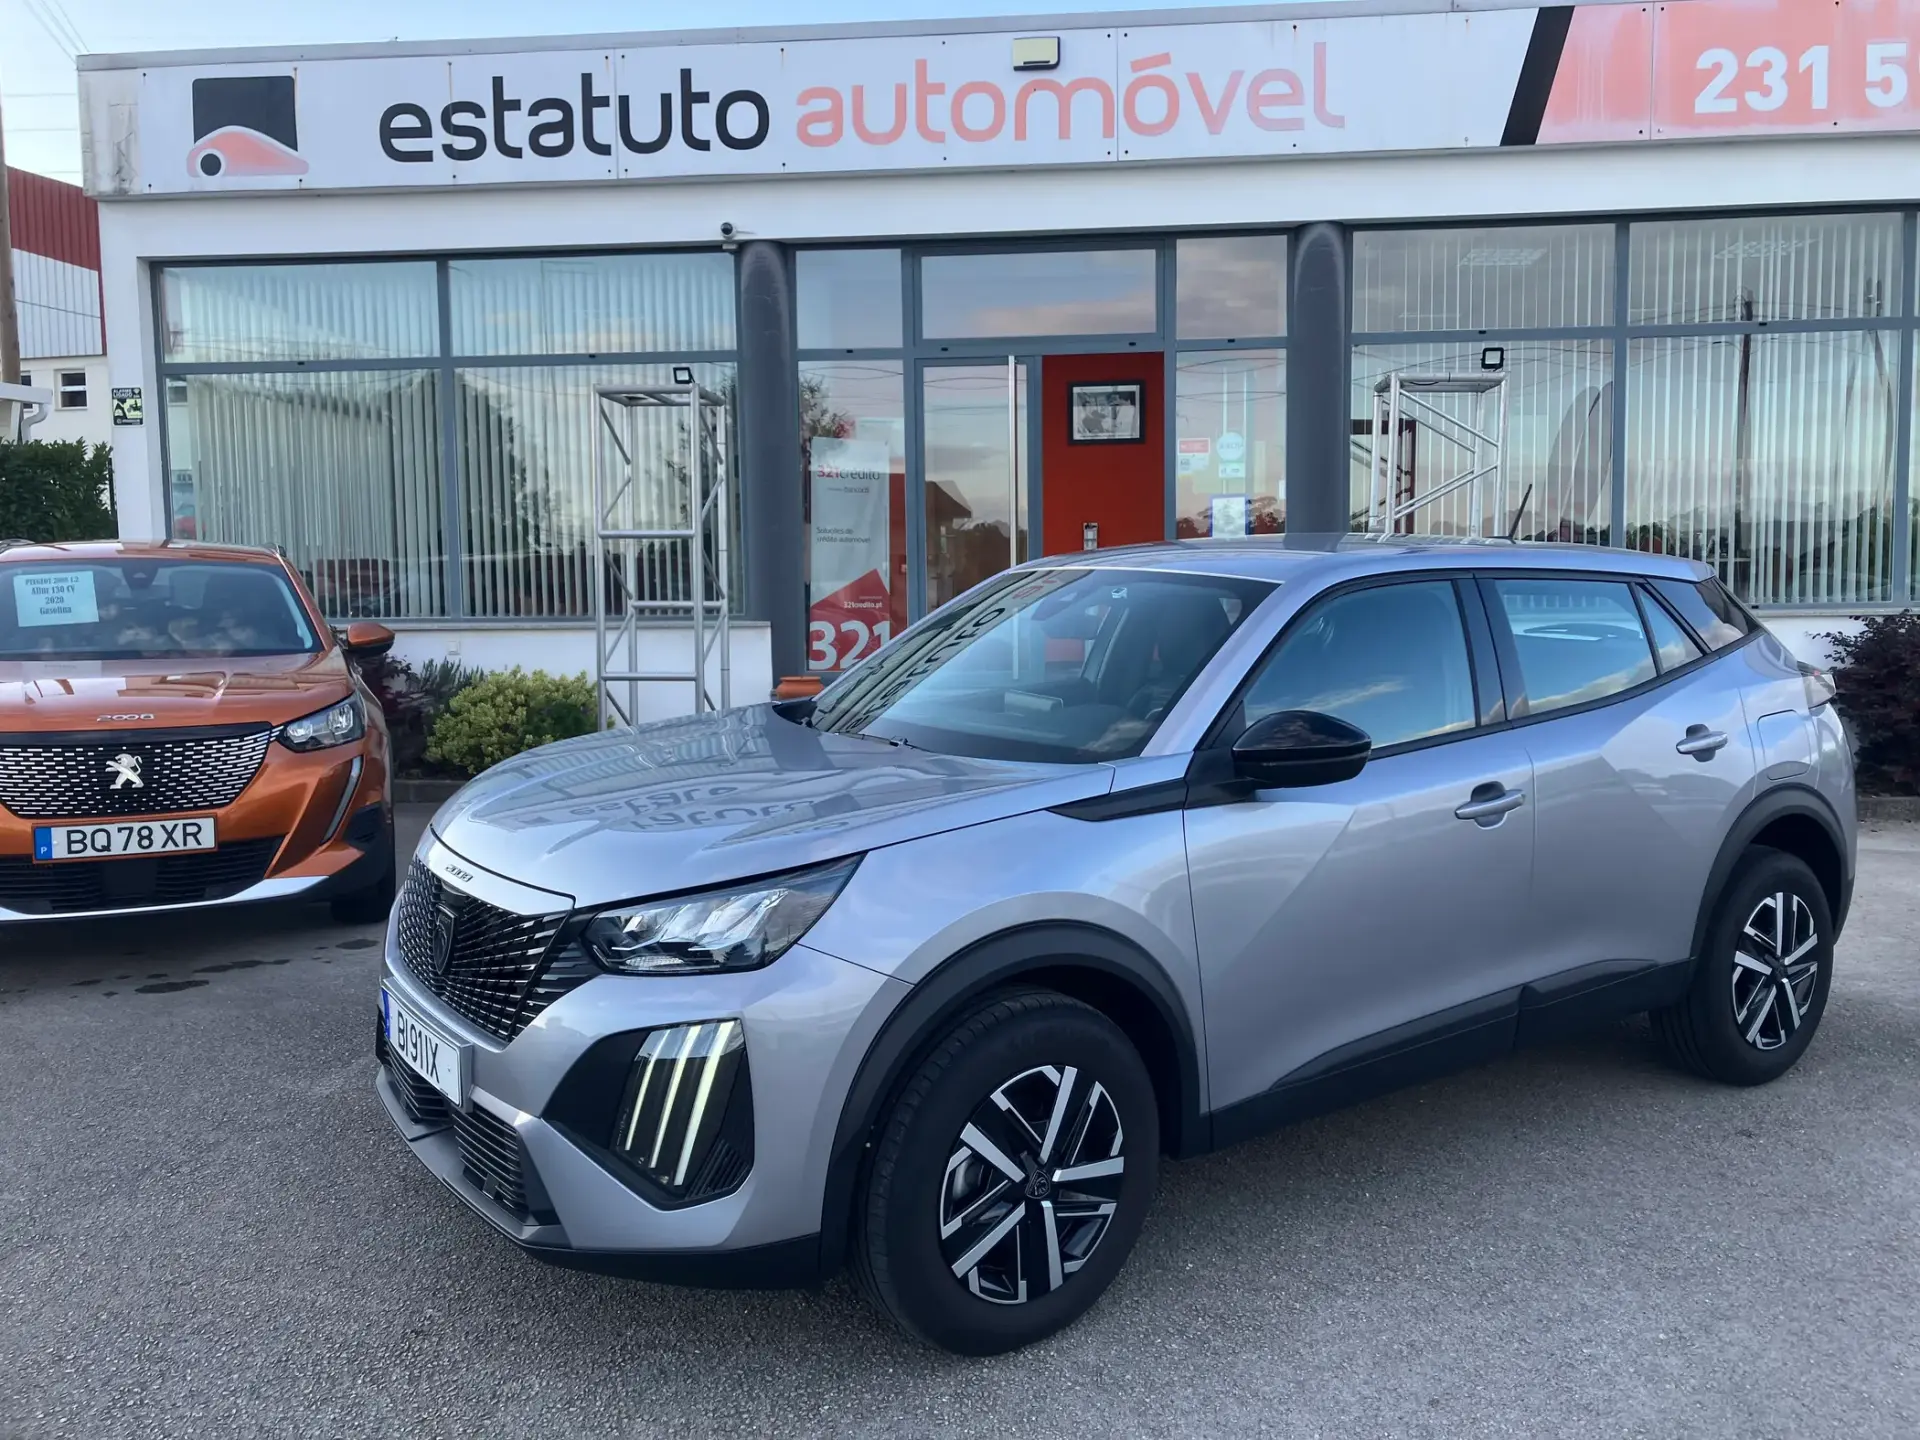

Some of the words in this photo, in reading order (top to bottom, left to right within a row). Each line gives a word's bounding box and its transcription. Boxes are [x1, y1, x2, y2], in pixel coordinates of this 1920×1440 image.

[1694, 45, 1829, 113] 231
[1864, 42, 1920, 108] 5
[379, 68, 770, 162] estatuto
[796, 41, 1346, 147] automóvel
[45, 596, 64, 605] 2020
[51, 585, 65, 595] 130
[40, 606, 72, 615] Gasolina
[808, 620, 890, 670] 321
